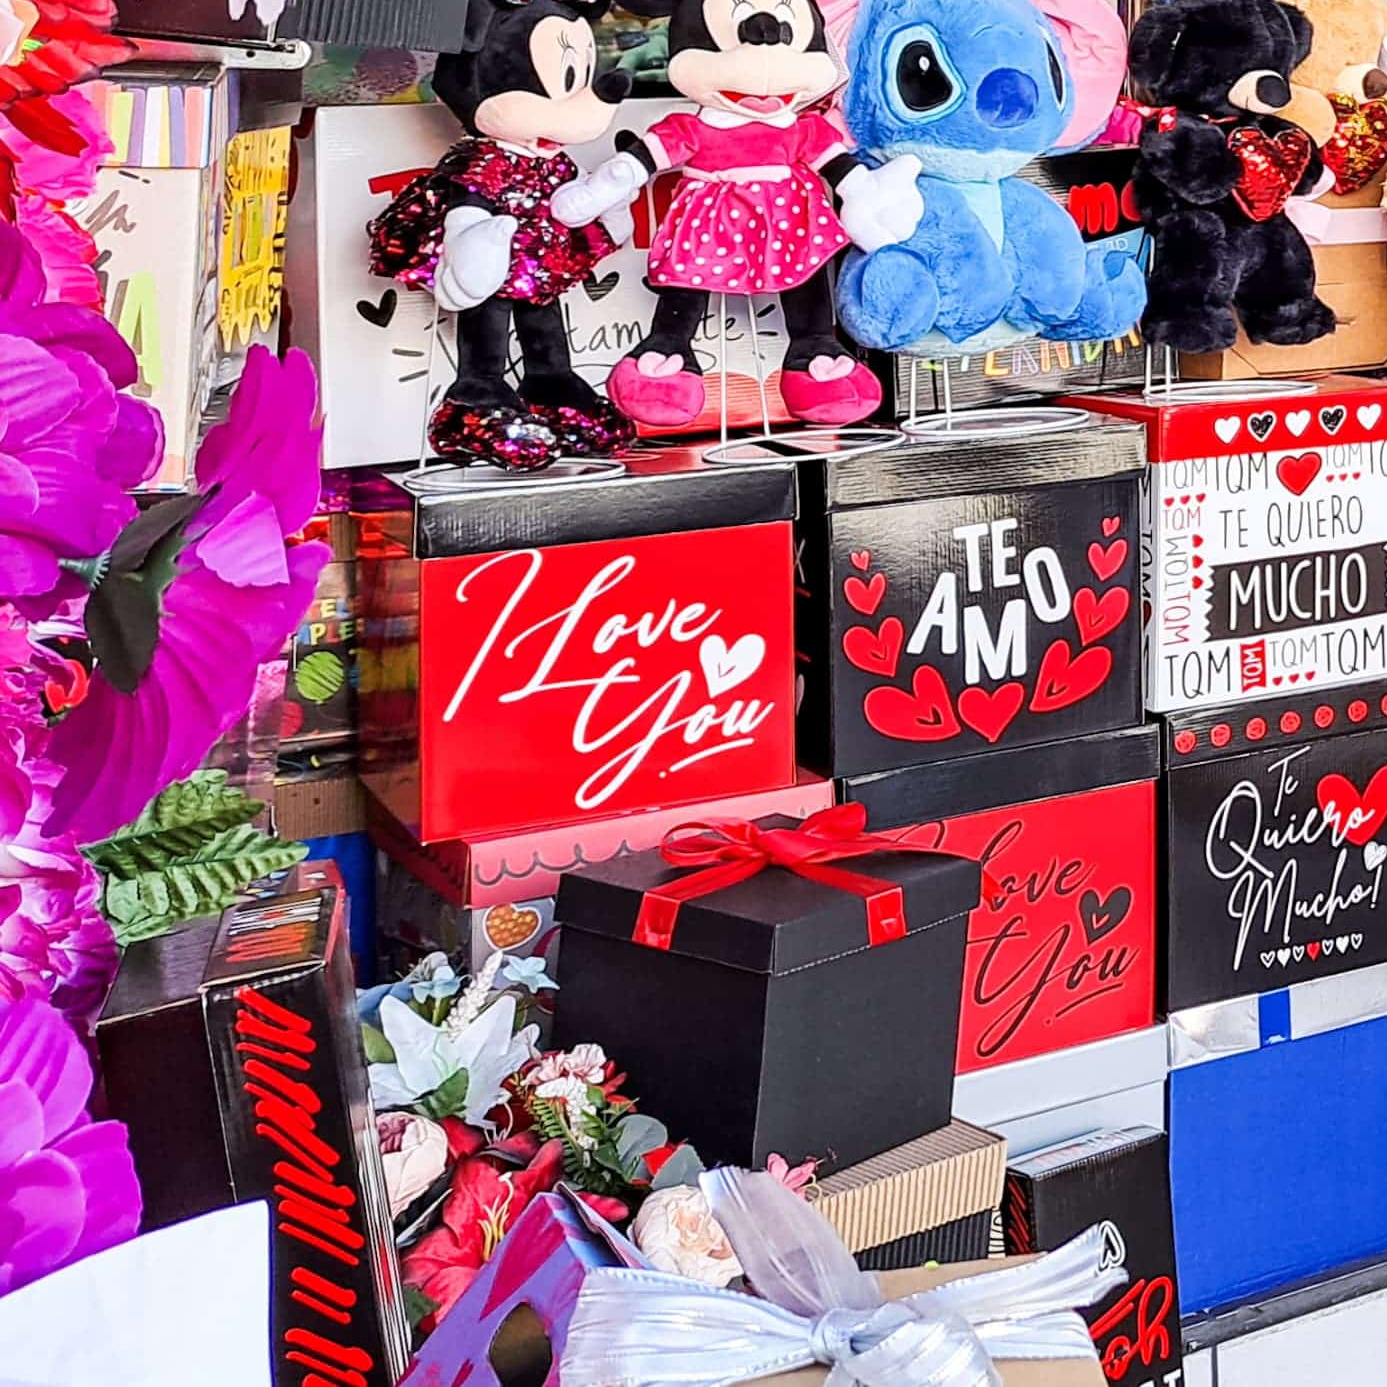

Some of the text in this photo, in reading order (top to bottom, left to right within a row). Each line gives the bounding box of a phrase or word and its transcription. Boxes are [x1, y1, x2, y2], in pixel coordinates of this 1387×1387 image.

[953, 516, 1021, 593] TE
[1219, 494, 1364, 550] TE QUIERO
[498, 555, 724, 704] Love
[1228, 551, 1370, 633] MUCHO
[1164, 645, 1232, 701] TQM
[1320, 623, 1387, 677] TQM
[572, 657, 776, 810] You
[1204, 778, 1377, 881] Quiero
[973, 916, 1140, 1059] You
